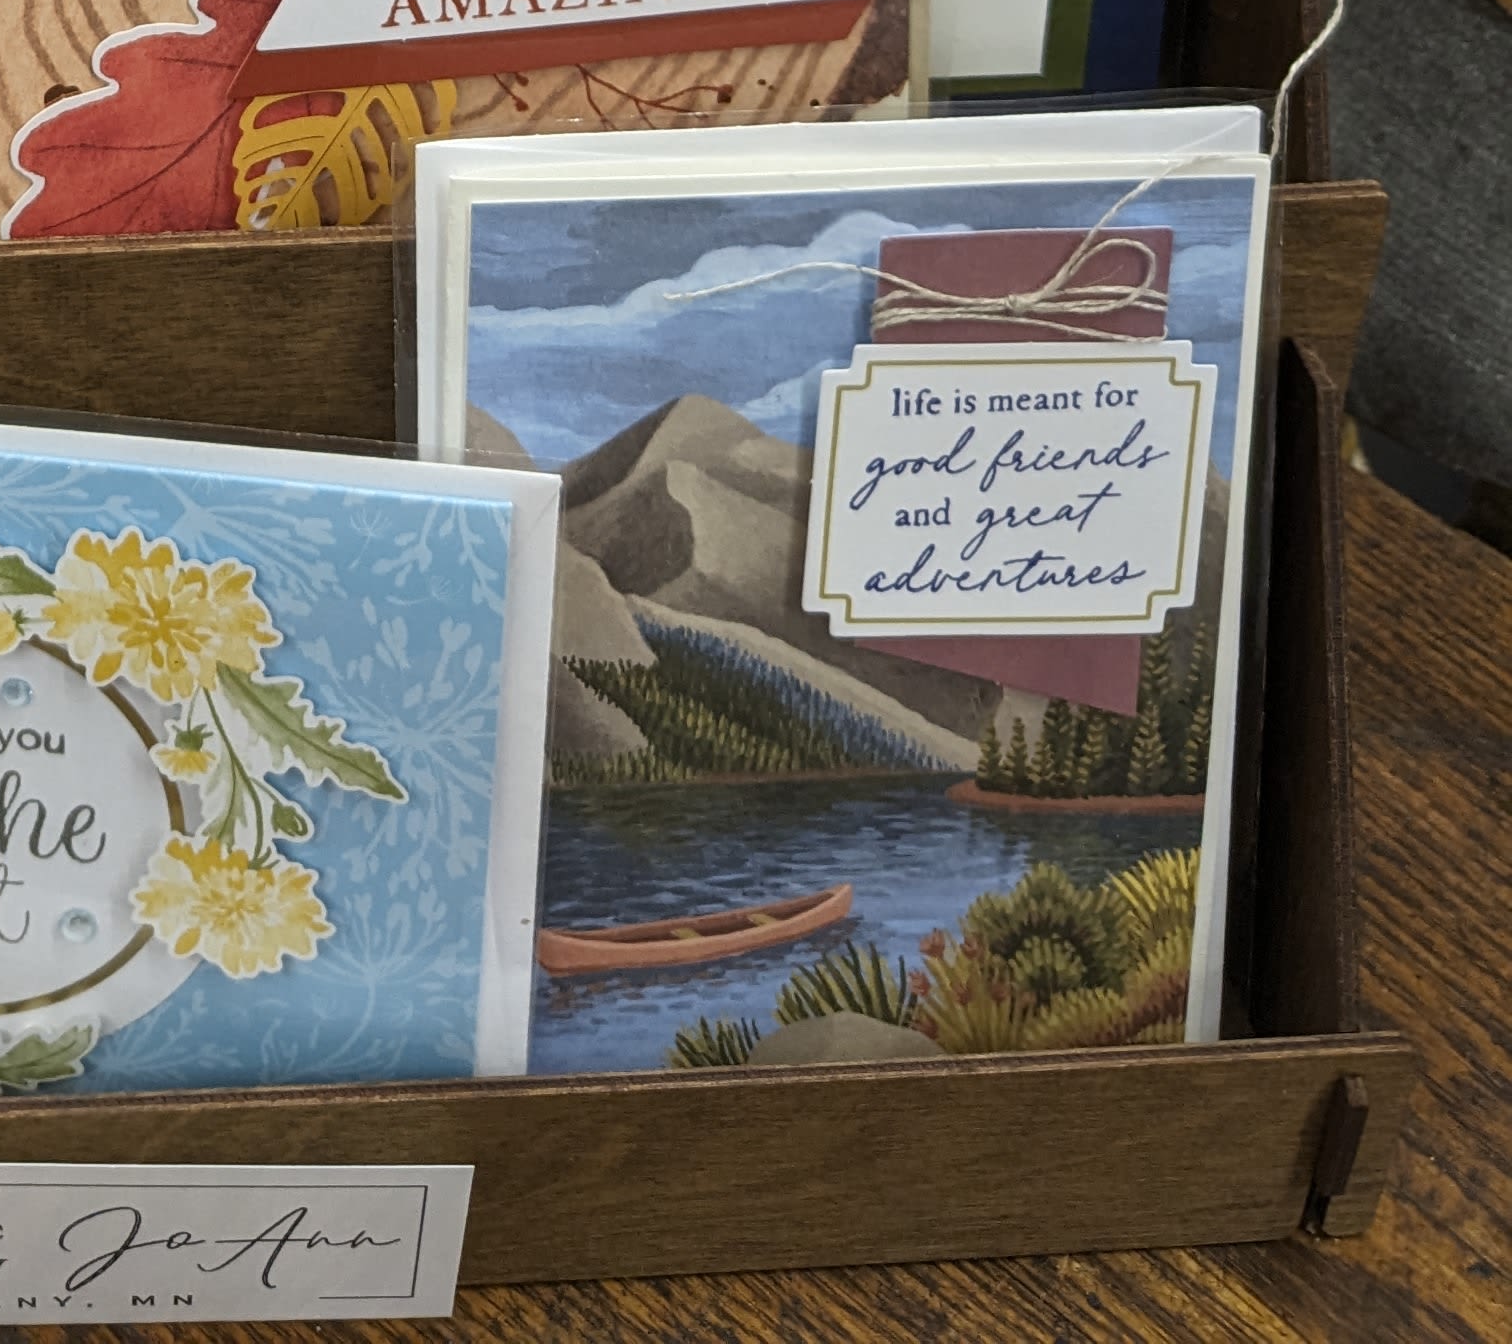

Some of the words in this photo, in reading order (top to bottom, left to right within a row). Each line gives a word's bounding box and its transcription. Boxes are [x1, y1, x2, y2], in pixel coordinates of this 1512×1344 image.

[892, 387, 941, 417] life
[953, 388, 976, 414] is
[987, 387, 1082, 413] meant
[1094, 381, 1139, 409] for
[849, 426, 976, 511] good
[979, 419, 1170, 492] friends
[894, 496, 951, 527] and
[960, 482, 1122, 561] great
[864, 543, 1147, 593] adventures
[131, 1293, 195, 1309] MN
